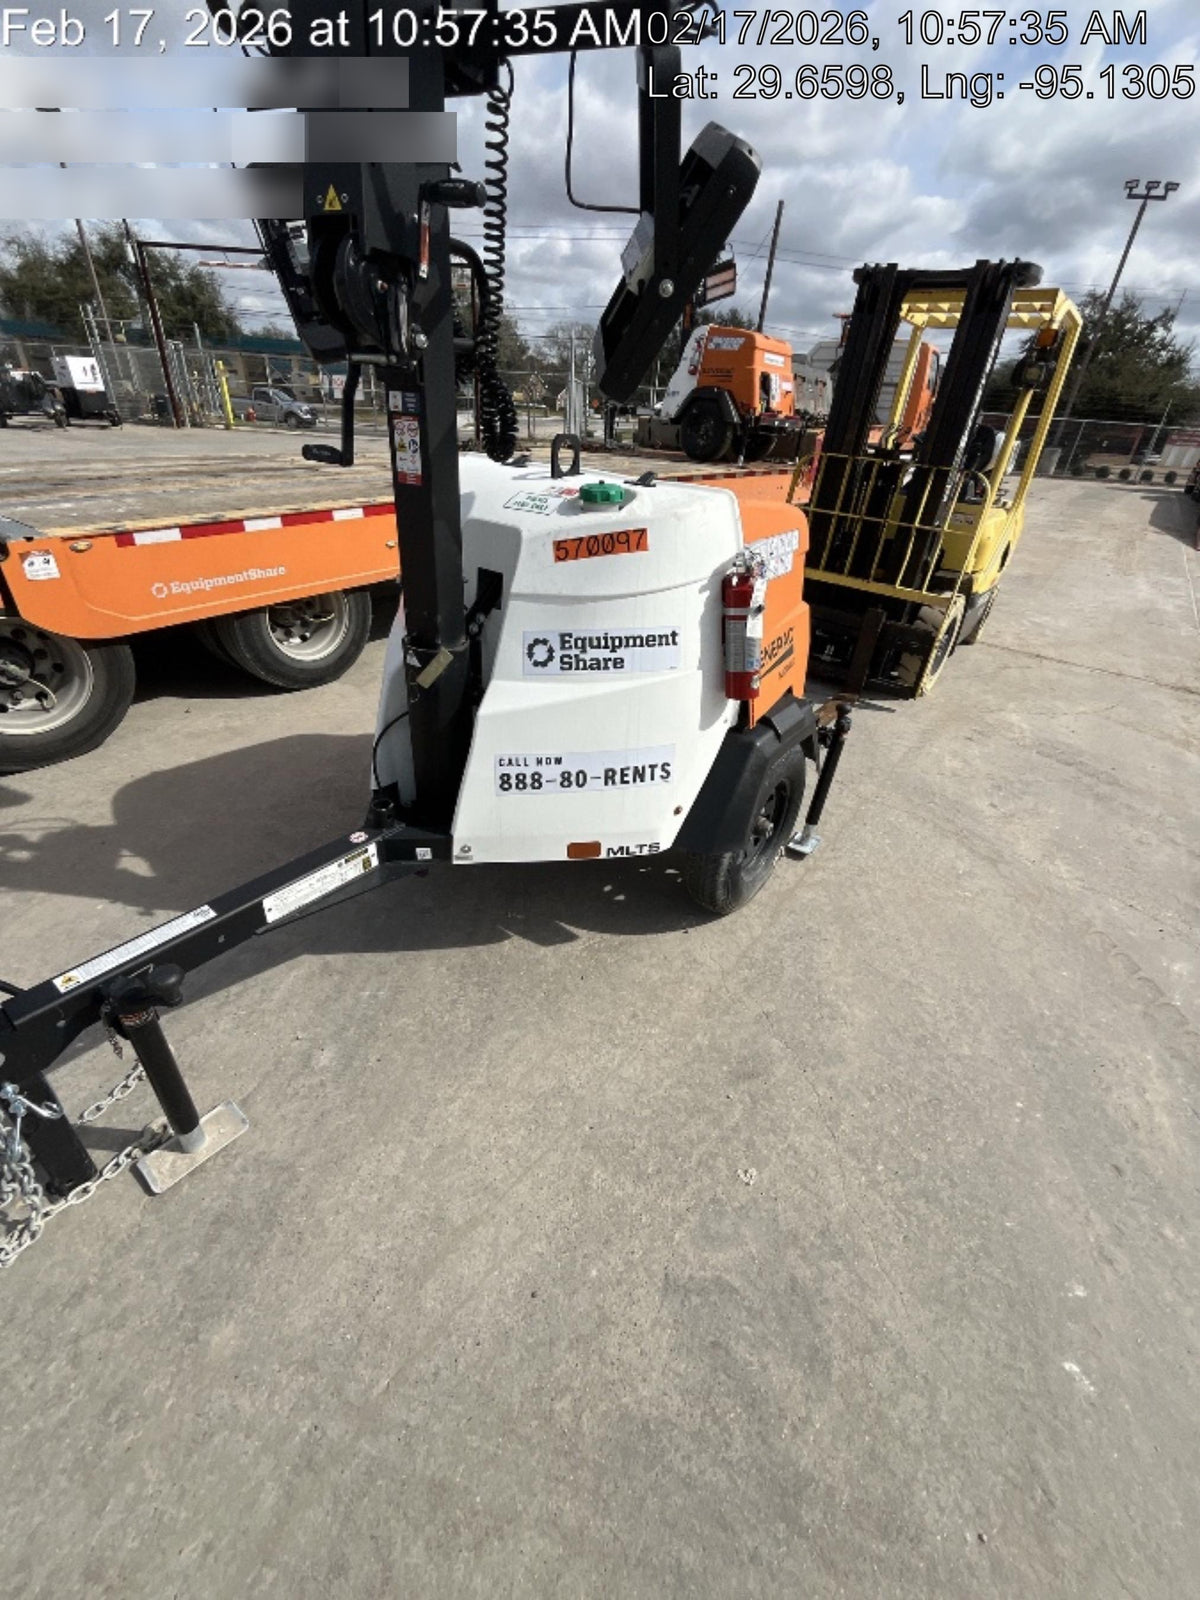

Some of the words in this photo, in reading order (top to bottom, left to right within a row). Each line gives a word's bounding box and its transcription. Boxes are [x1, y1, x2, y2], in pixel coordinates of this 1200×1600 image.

[556, 530, 645, 561] 570097
[170, 566, 286, 594] EquipmentShare
[559, 631, 679, 655] Equipment
[560, 654, 625, 672] Share
[499, 757, 529, 767] CALL
[499, 762, 671, 791] 888-80-RENTS
[606, 843, 661, 857] MLTS
